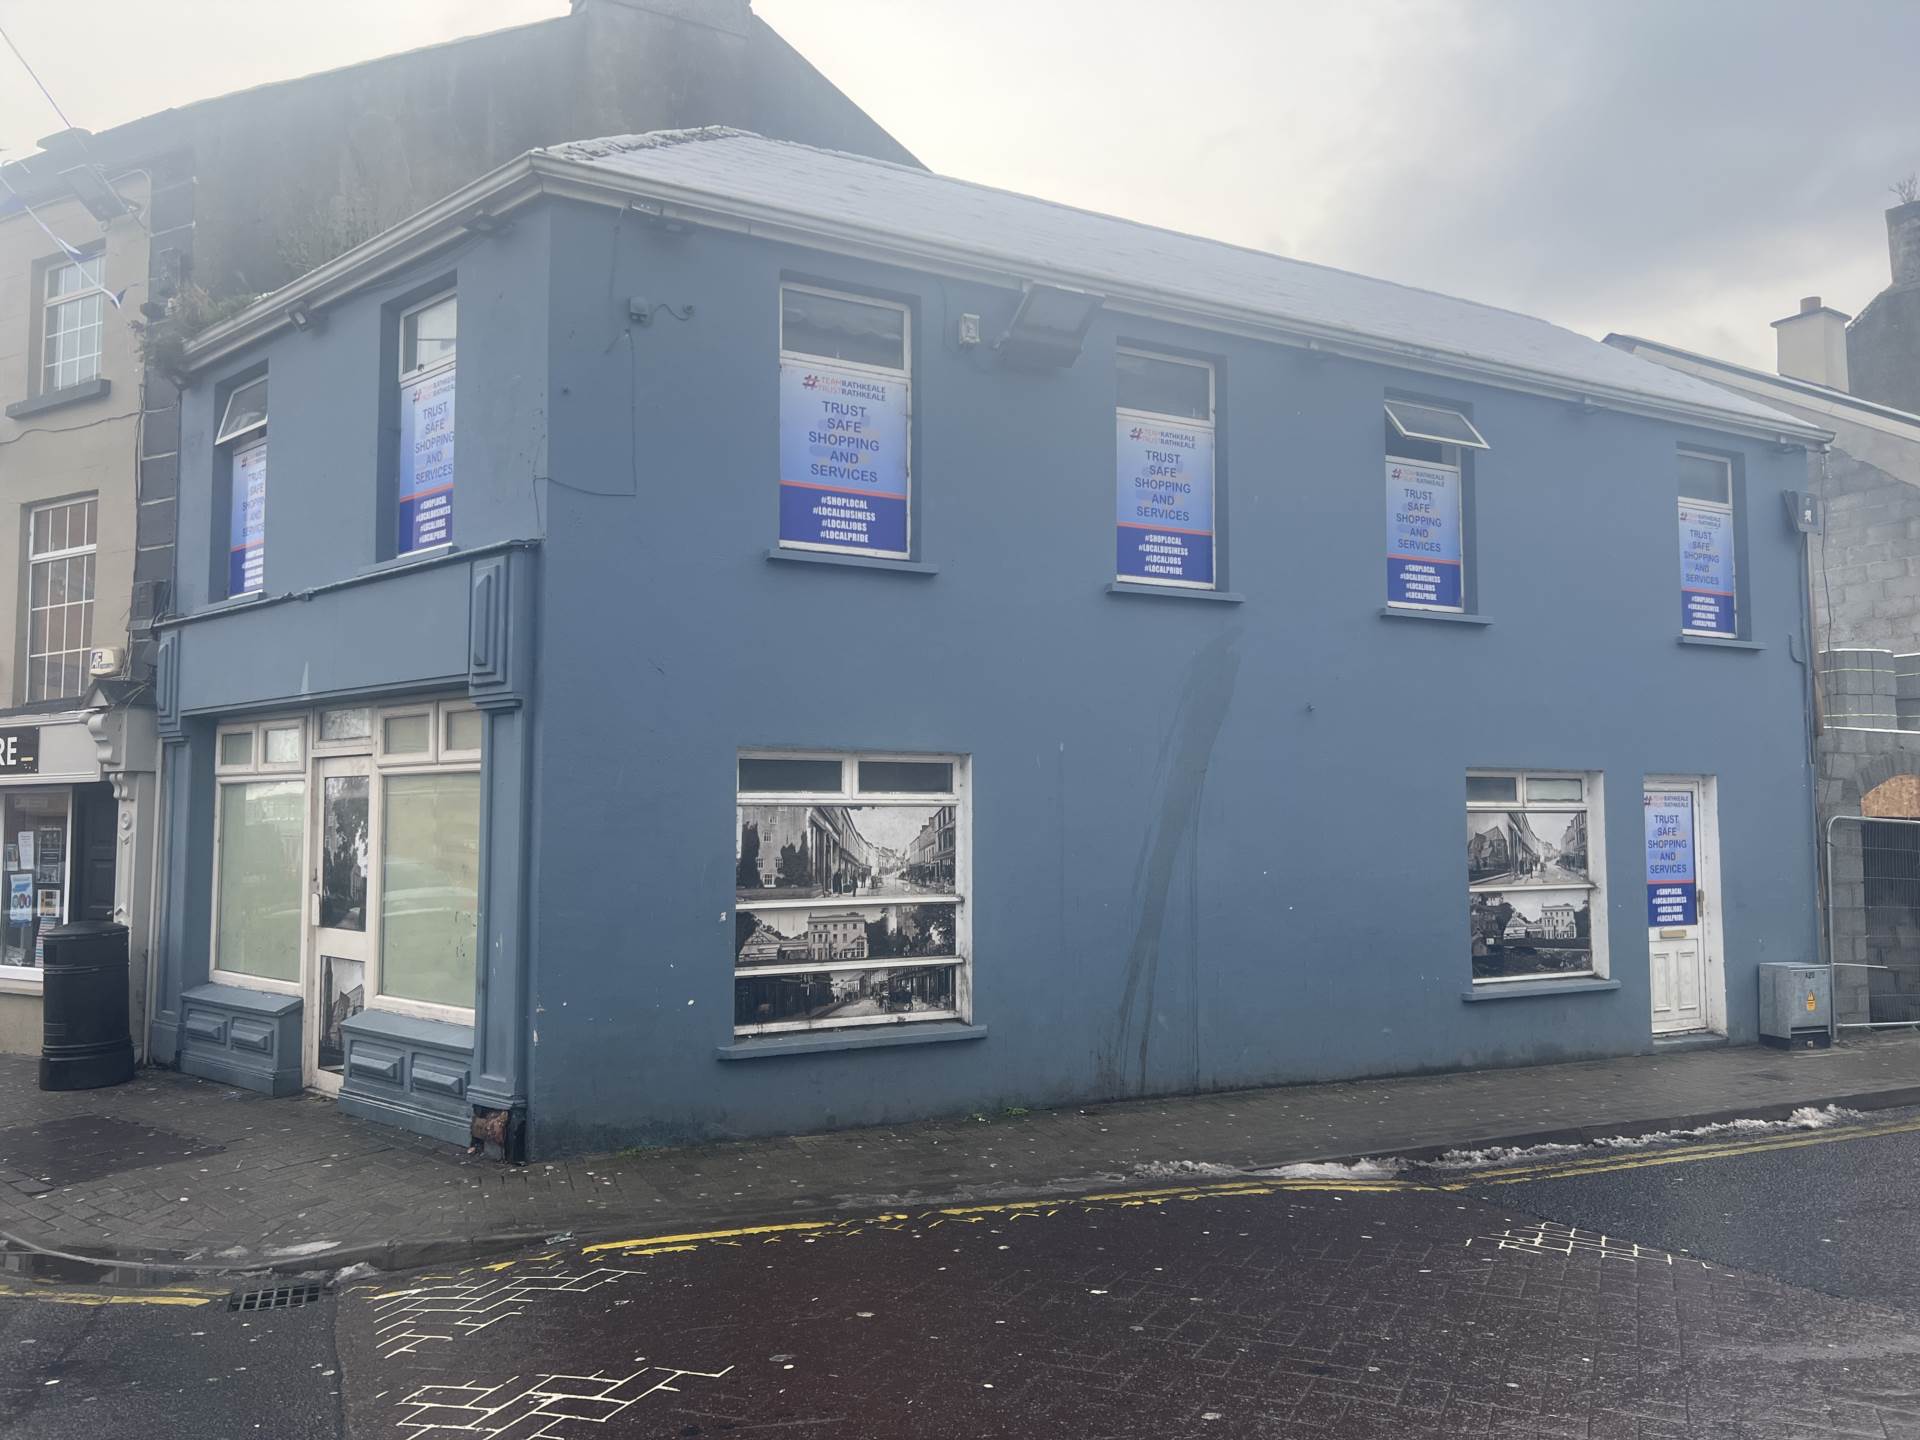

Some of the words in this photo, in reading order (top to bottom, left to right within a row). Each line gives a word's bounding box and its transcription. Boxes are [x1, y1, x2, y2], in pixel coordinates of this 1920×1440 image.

[841, 380, 886, 394] RATHKEALE
[841, 388, 886, 401] RATHKEALE
[423, 401, 447, 419] TRUST
[822, 400, 867, 417] TRUST
[424, 418, 444, 434] SAFE
[827, 418, 861, 433] SAFE
[415, 432, 455, 454] SHOPPING
[808, 431, 880, 451] SHOPPING
[425, 451, 442, 464] AND
[830, 451, 859, 464] AND
[1146, 450, 1180, 464] TRUST
[415, 464, 453, 484] SERVICES
[811, 463, 878, 483] SERVICES
[1149, 465, 1177, 478] SAFE
[1135, 477, 1191, 494] SHOPPING
[1152, 494, 1175, 506] AND
[1404, 488, 1432, 501] TRUST
[821, 496, 868, 509] #SHOPLOCAL
[1407, 502, 1430, 513] SAFE
[812, 507, 876, 521] #LOCALBUSINESS
[1136, 506, 1190, 521] SERVICES
[1396, 513, 1442, 527] SHOPPING
[822, 519, 867, 531] #LOCALJOBS
[820, 530, 869, 543] #LOCALPRIDE
[1410, 527, 1429, 538] AND
[1689, 529, 1712, 540] TRUST
[1398, 539, 1441, 552] SERVICES
[1686, 574, 1719, 584] SERVICES
[1654, 815, 1679, 824] TRUST
[1657, 827, 1677, 836] SAFE
[1648, 840, 1687, 848] SHOPPING
[1660, 852, 1676, 861] AND
[1649, 864, 1687, 874] SERVICES
